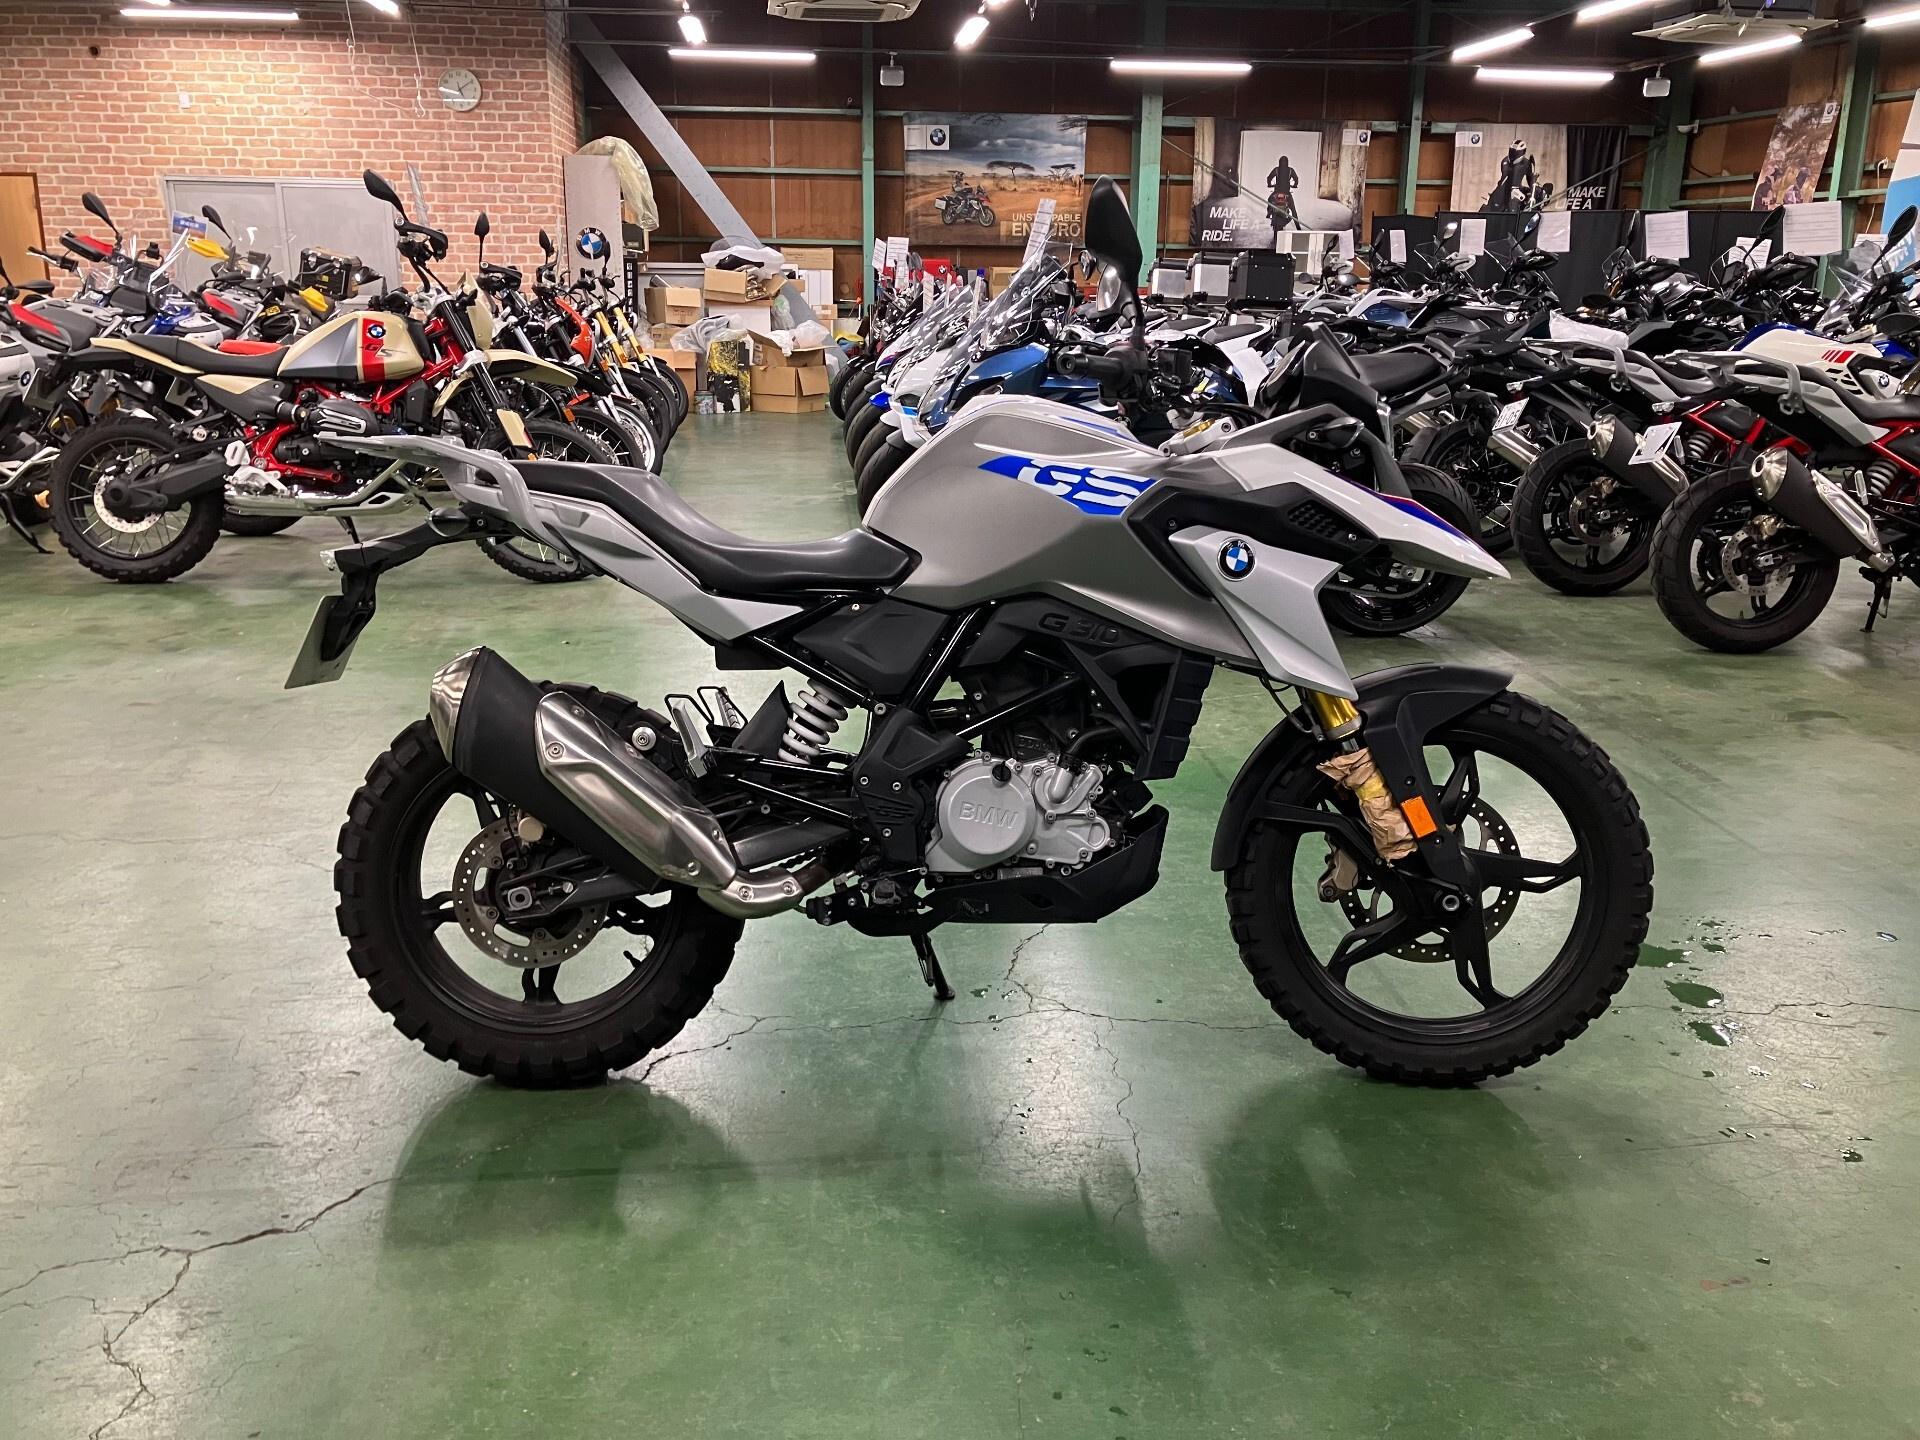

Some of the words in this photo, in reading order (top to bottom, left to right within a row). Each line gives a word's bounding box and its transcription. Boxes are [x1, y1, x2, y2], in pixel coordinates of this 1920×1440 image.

[1568, 186, 1606, 198] MAKE
[1555, 198, 1582, 209] LIFE
[1582, 199, 1592, 210] A
[1012, 213, 1081, 222] UNSPABLE
[1209, 207, 1248, 219] MAKE
[1011, 222, 1081, 237] ENURO
[1222, 219, 1249, 230] LIFE
[1251, 219, 1260, 230] A
[1201, 229, 1233, 242] RIDE.
[1016, 458, 1151, 508] GS
[958, 801, 1019, 829] BMW
